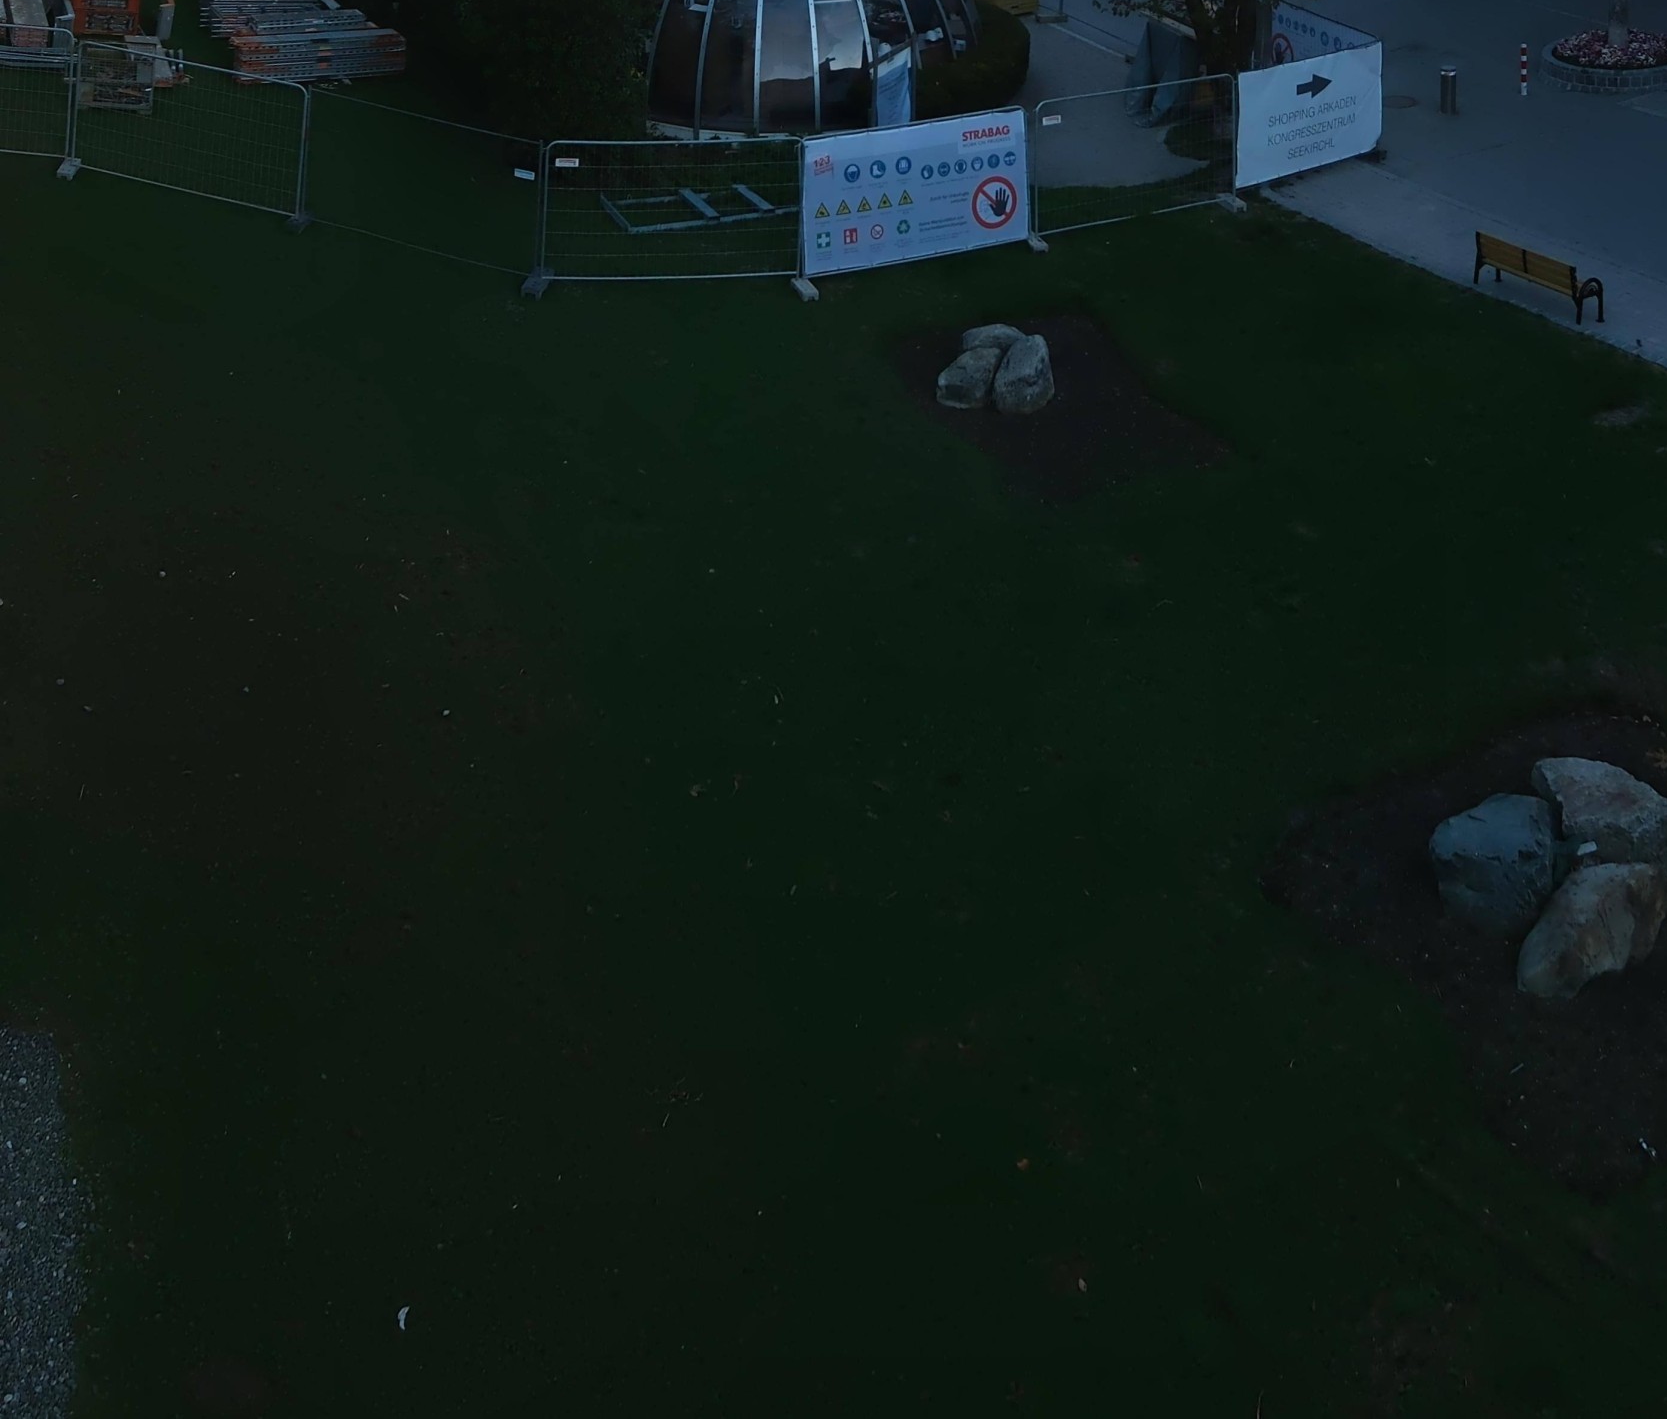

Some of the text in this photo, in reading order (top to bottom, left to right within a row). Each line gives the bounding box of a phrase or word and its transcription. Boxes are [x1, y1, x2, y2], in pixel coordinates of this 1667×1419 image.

[1268, 95, 1356, 128] SHOPPING ARKADEN
[962, 125, 1010, 141] STRABAG
[1267, 113, 1356, 146] KONGRESSZENTRUM
[1288, 138, 1335, 159] SEEKIRCHL
